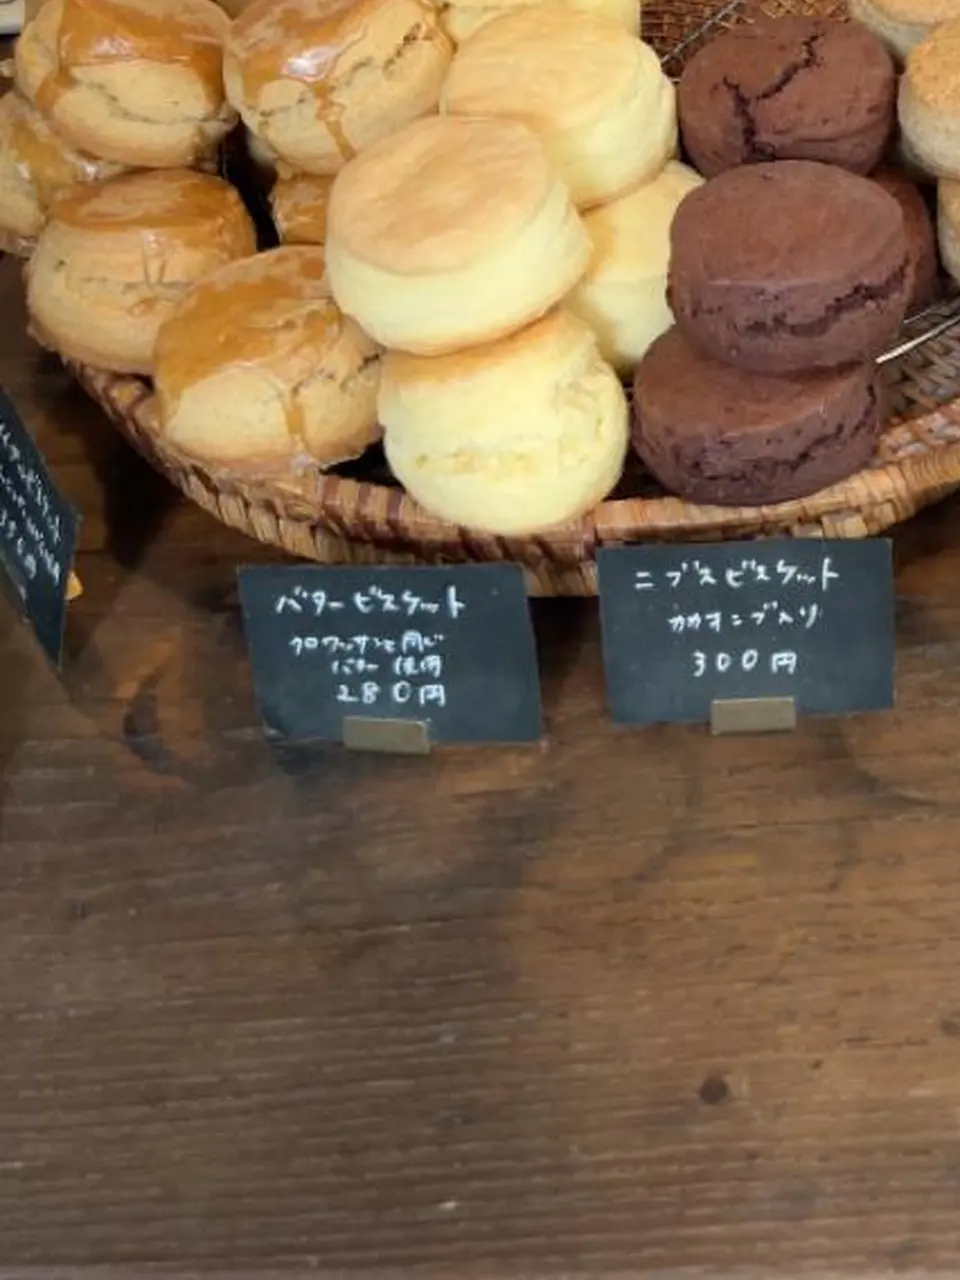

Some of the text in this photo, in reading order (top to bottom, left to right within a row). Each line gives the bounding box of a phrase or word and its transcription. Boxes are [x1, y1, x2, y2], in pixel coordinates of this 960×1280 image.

[634, 556, 840, 591] ニブスビスケット
[275, 584, 467, 618] バタービスケット
[288, 629, 445, 656] クロワッサンと同じ
[692, 648, 798, 677] 300円
[335, 680, 447, 707] 280円
